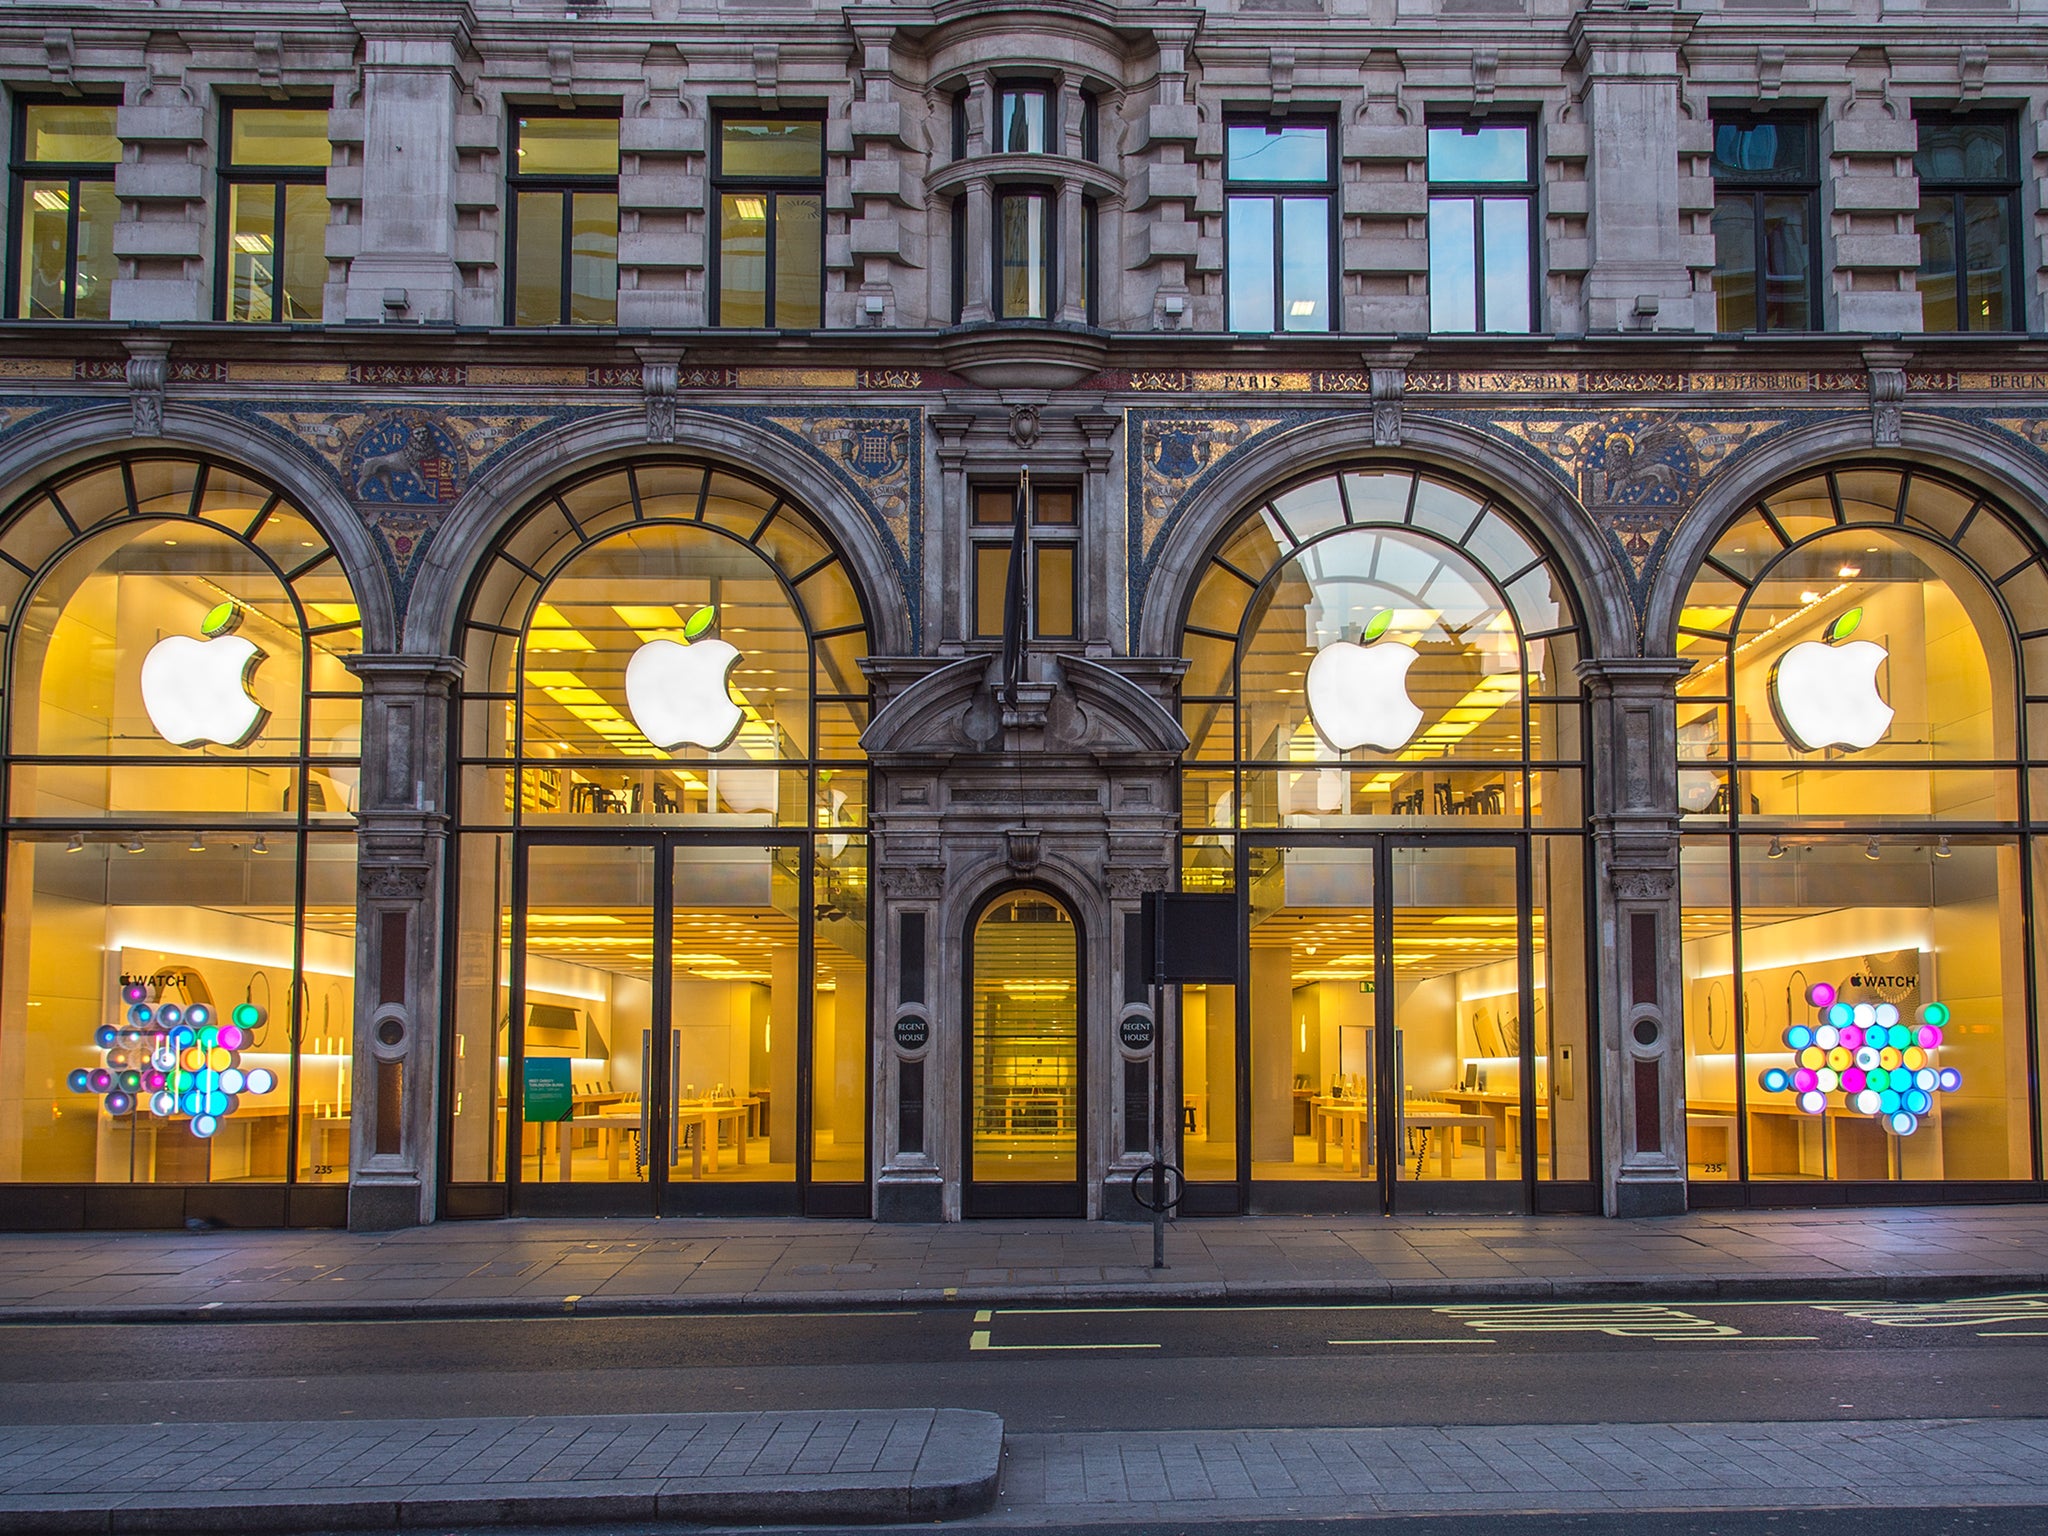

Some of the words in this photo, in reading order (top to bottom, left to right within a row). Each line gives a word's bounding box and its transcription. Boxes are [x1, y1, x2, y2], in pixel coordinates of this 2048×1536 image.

[1224, 375, 1281, 389] PARIS
[1466, 375, 1511, 389] NEW
[1713, 375, 1803, 389] PETERSBURG
[1990, 374, 2046, 389] BERLIN
[133, 975, 187, 987] WATCH
[1863, 976, 1916, 988] WATCH
[897, 1023, 926, 1031] REGENT
[1123, 1023, 1151, 1031] REGENT
[898, 1033, 925, 1041] HOUSE
[1124, 1033, 1150, 1041] HOUSE
[314, 1164, 333, 1175] 235
[1704, 1163, 1722, 1173] 235
[1432, 1303, 1743, 1337] STOP
